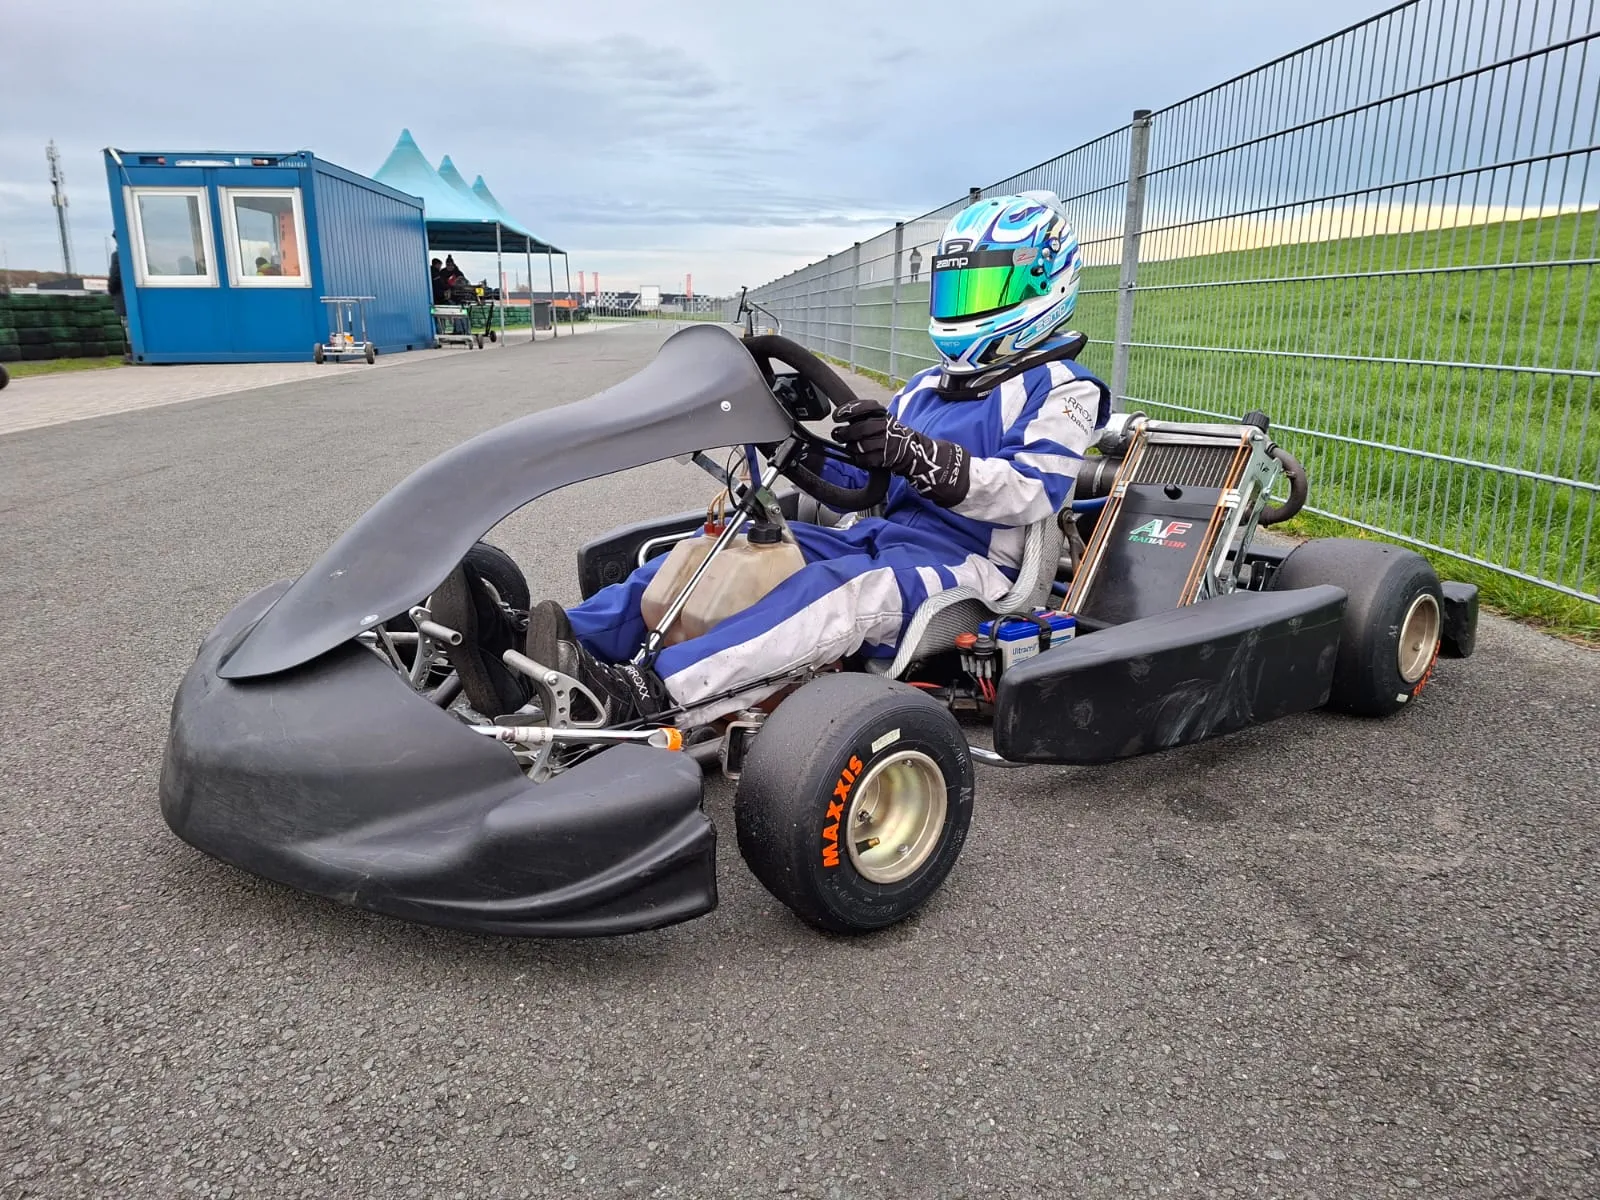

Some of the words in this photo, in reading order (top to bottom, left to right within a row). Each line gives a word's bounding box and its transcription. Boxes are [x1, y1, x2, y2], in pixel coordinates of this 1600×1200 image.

[936, 257, 969, 269] zamp
[1129, 518, 1193, 539] AF
[1127, 534, 1187, 549] RADIATOR
[822, 754, 863, 867] MAXXIS
